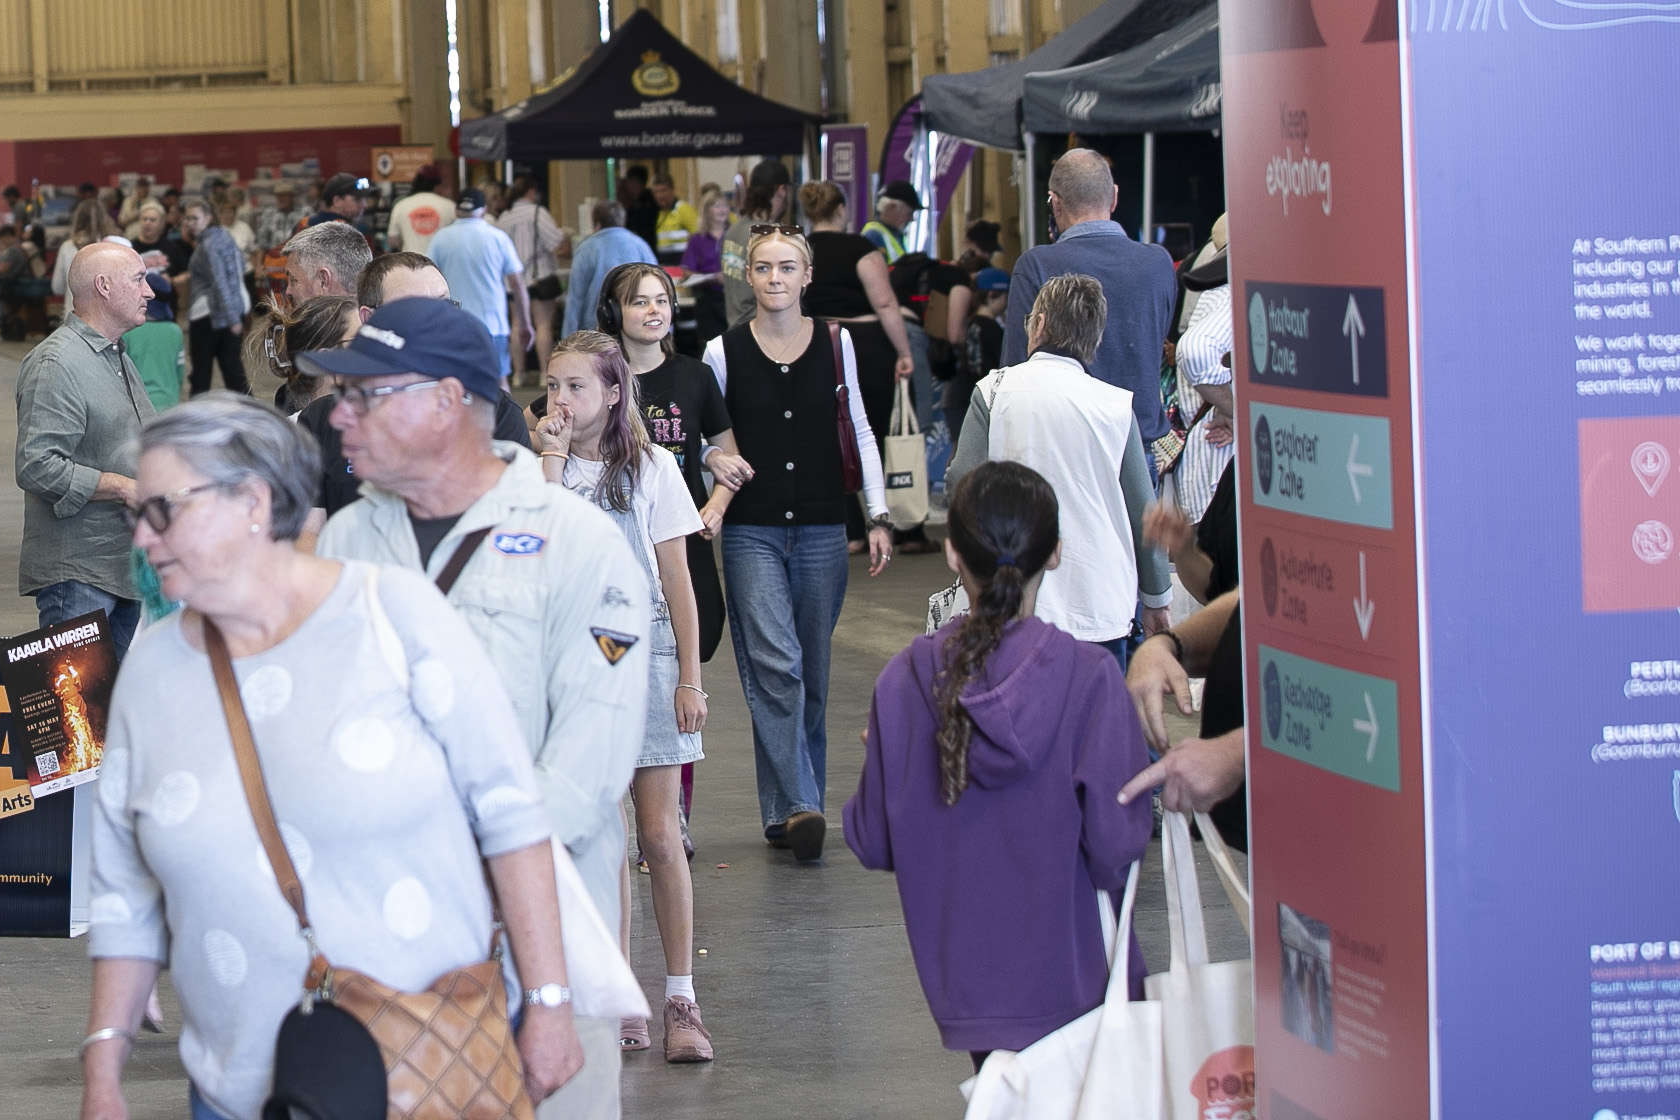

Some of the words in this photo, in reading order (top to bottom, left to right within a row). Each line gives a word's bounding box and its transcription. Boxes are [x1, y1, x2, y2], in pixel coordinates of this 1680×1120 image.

[600, 130, 744, 148] www.border.gov.au
[1266, 146, 1332, 216] exploring
[1572, 238, 1591, 256] At
[1594, 236, 1667, 255] Southern
[1573, 258, 1645, 280] including
[1647, 259, 1675, 275] our
[1574, 279, 1651, 298] industries
[1653, 278, 1669, 296] in
[1574, 302, 1602, 320] the
[1575, 334, 1604, 352] We
[1605, 332, 1646, 351] work
[1271, 340, 1297, 376] Zone
[1576, 375, 1663, 397] seamlessly
[1278, 464, 1304, 500] Zone
[7, 637, 54, 663] KAARLA
[53, 621, 100, 647] WIRREN
[22, 704, 36, 714] FREE
[37, 698, 55, 709] EVENT
[27, 723, 37, 732] SAT
[46, 716, 59, 725] MAY
[2, 793, 33, 813] Arts
[1590, 943, 1639, 963] PORT
[1640, 941, 1666, 961] OF
